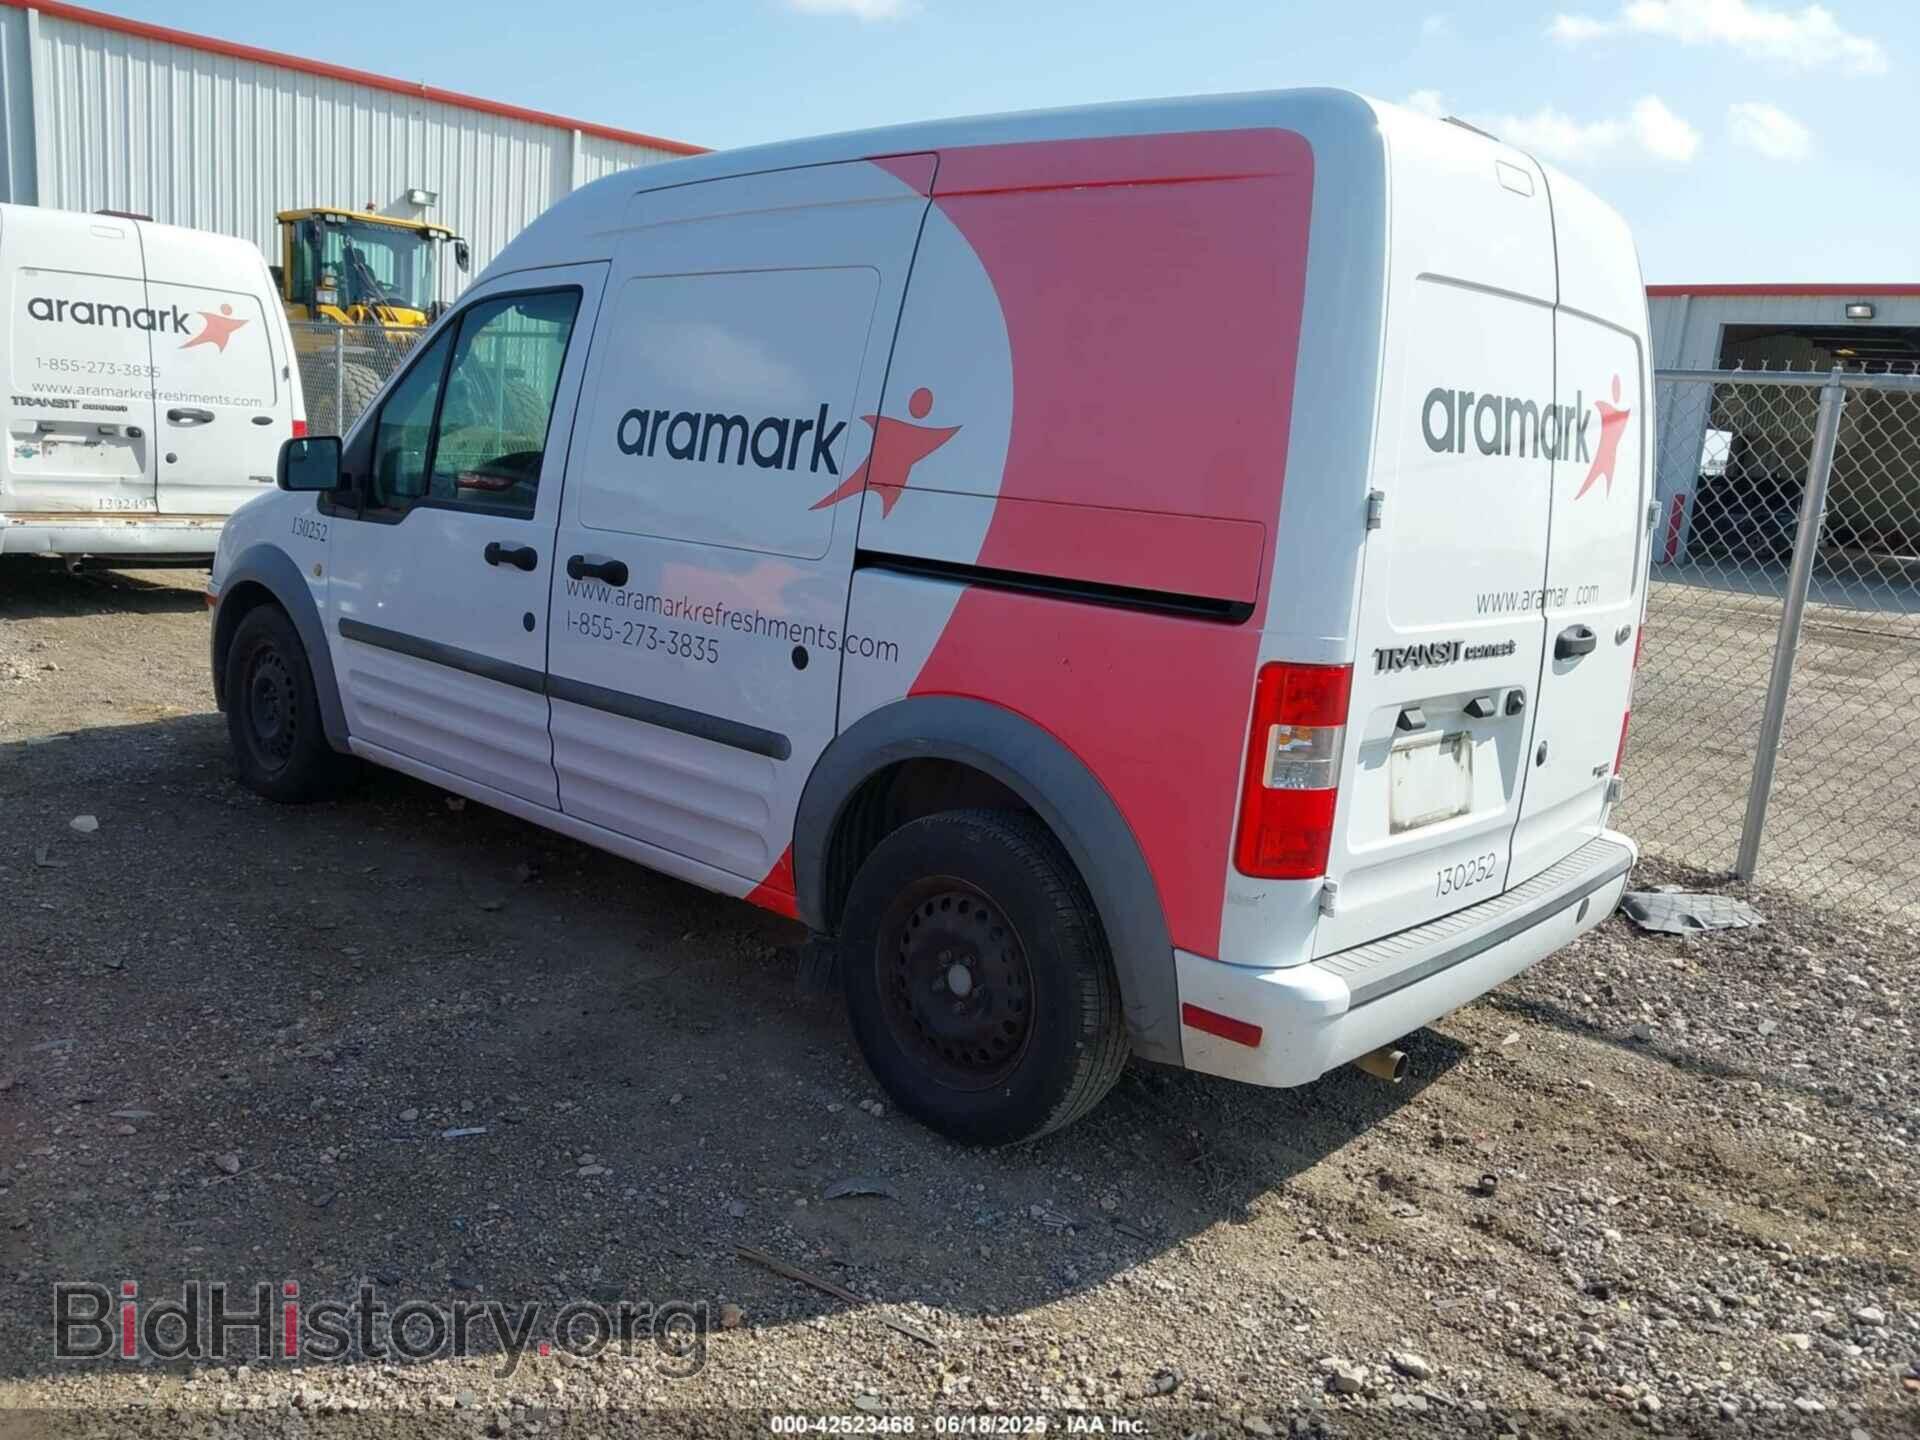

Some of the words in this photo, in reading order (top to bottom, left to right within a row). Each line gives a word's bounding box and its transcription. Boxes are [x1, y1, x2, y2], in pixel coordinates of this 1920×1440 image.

[27, 296, 191, 335] aramark
[35, 356, 161, 378] 1-855-273-3835
[10, 395, 80, 409] TRANSIT
[31, 382, 262, 408] www.aramarkrefreshments.com
[616, 403, 847, 475] aramark
[1421, 387, 1591, 463] aramark
[291, 516, 328, 543] 130252
[566, 579, 899, 663] www.aramarkrefreshments.com
[567, 610, 720, 664] 1-855-273-3835
[1373, 640, 1465, 674] TRANSIT
[1435, 852, 1496, 897] 130252
